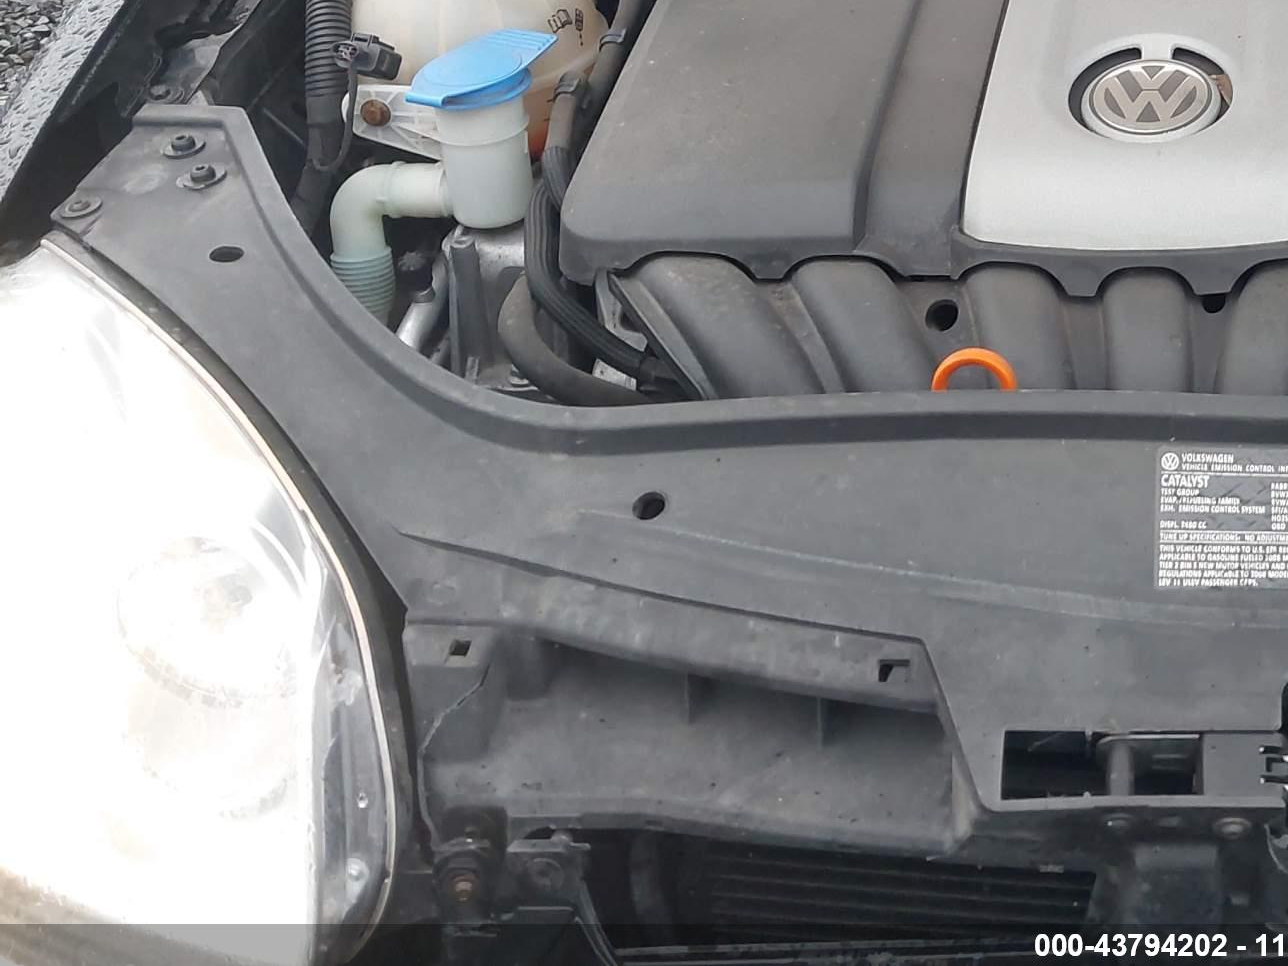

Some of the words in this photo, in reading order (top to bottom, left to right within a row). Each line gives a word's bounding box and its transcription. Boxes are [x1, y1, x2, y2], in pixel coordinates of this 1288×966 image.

[1182, 453, 1234, 463] VOLKSWAGEN
[1161, 474, 1210, 488] CATALYST
[1218, 497, 1240, 505] FAMILY
[1204, 545, 1240, 553] CONFORMS
[1241, 545, 1250, 553] TO
[1160, 553, 1195, 561] APPLICABLE
[1197, 553, 1206, 561] TO
[1240, 554, 1264, 562] FUELED
[1160, 561, 1173, 569] TIER
[1180, 561, 1193, 569] BIN
[1216, 562, 1239, 570] MOTOR
[1240, 562, 1269, 570] VEHICLES
[1271, 562, 1285, 570] AND
[1159, 570, 1201, 578] REGULATIONS
[1203, 570, 1239, 578] APPLICABLE
[1241, 570, 1249, 578] TO
[1159, 578, 1171, 586] LEV
[1183, 578, 1200, 586] ULEV
[1201, 578, 1238, 586] PASSENGER
